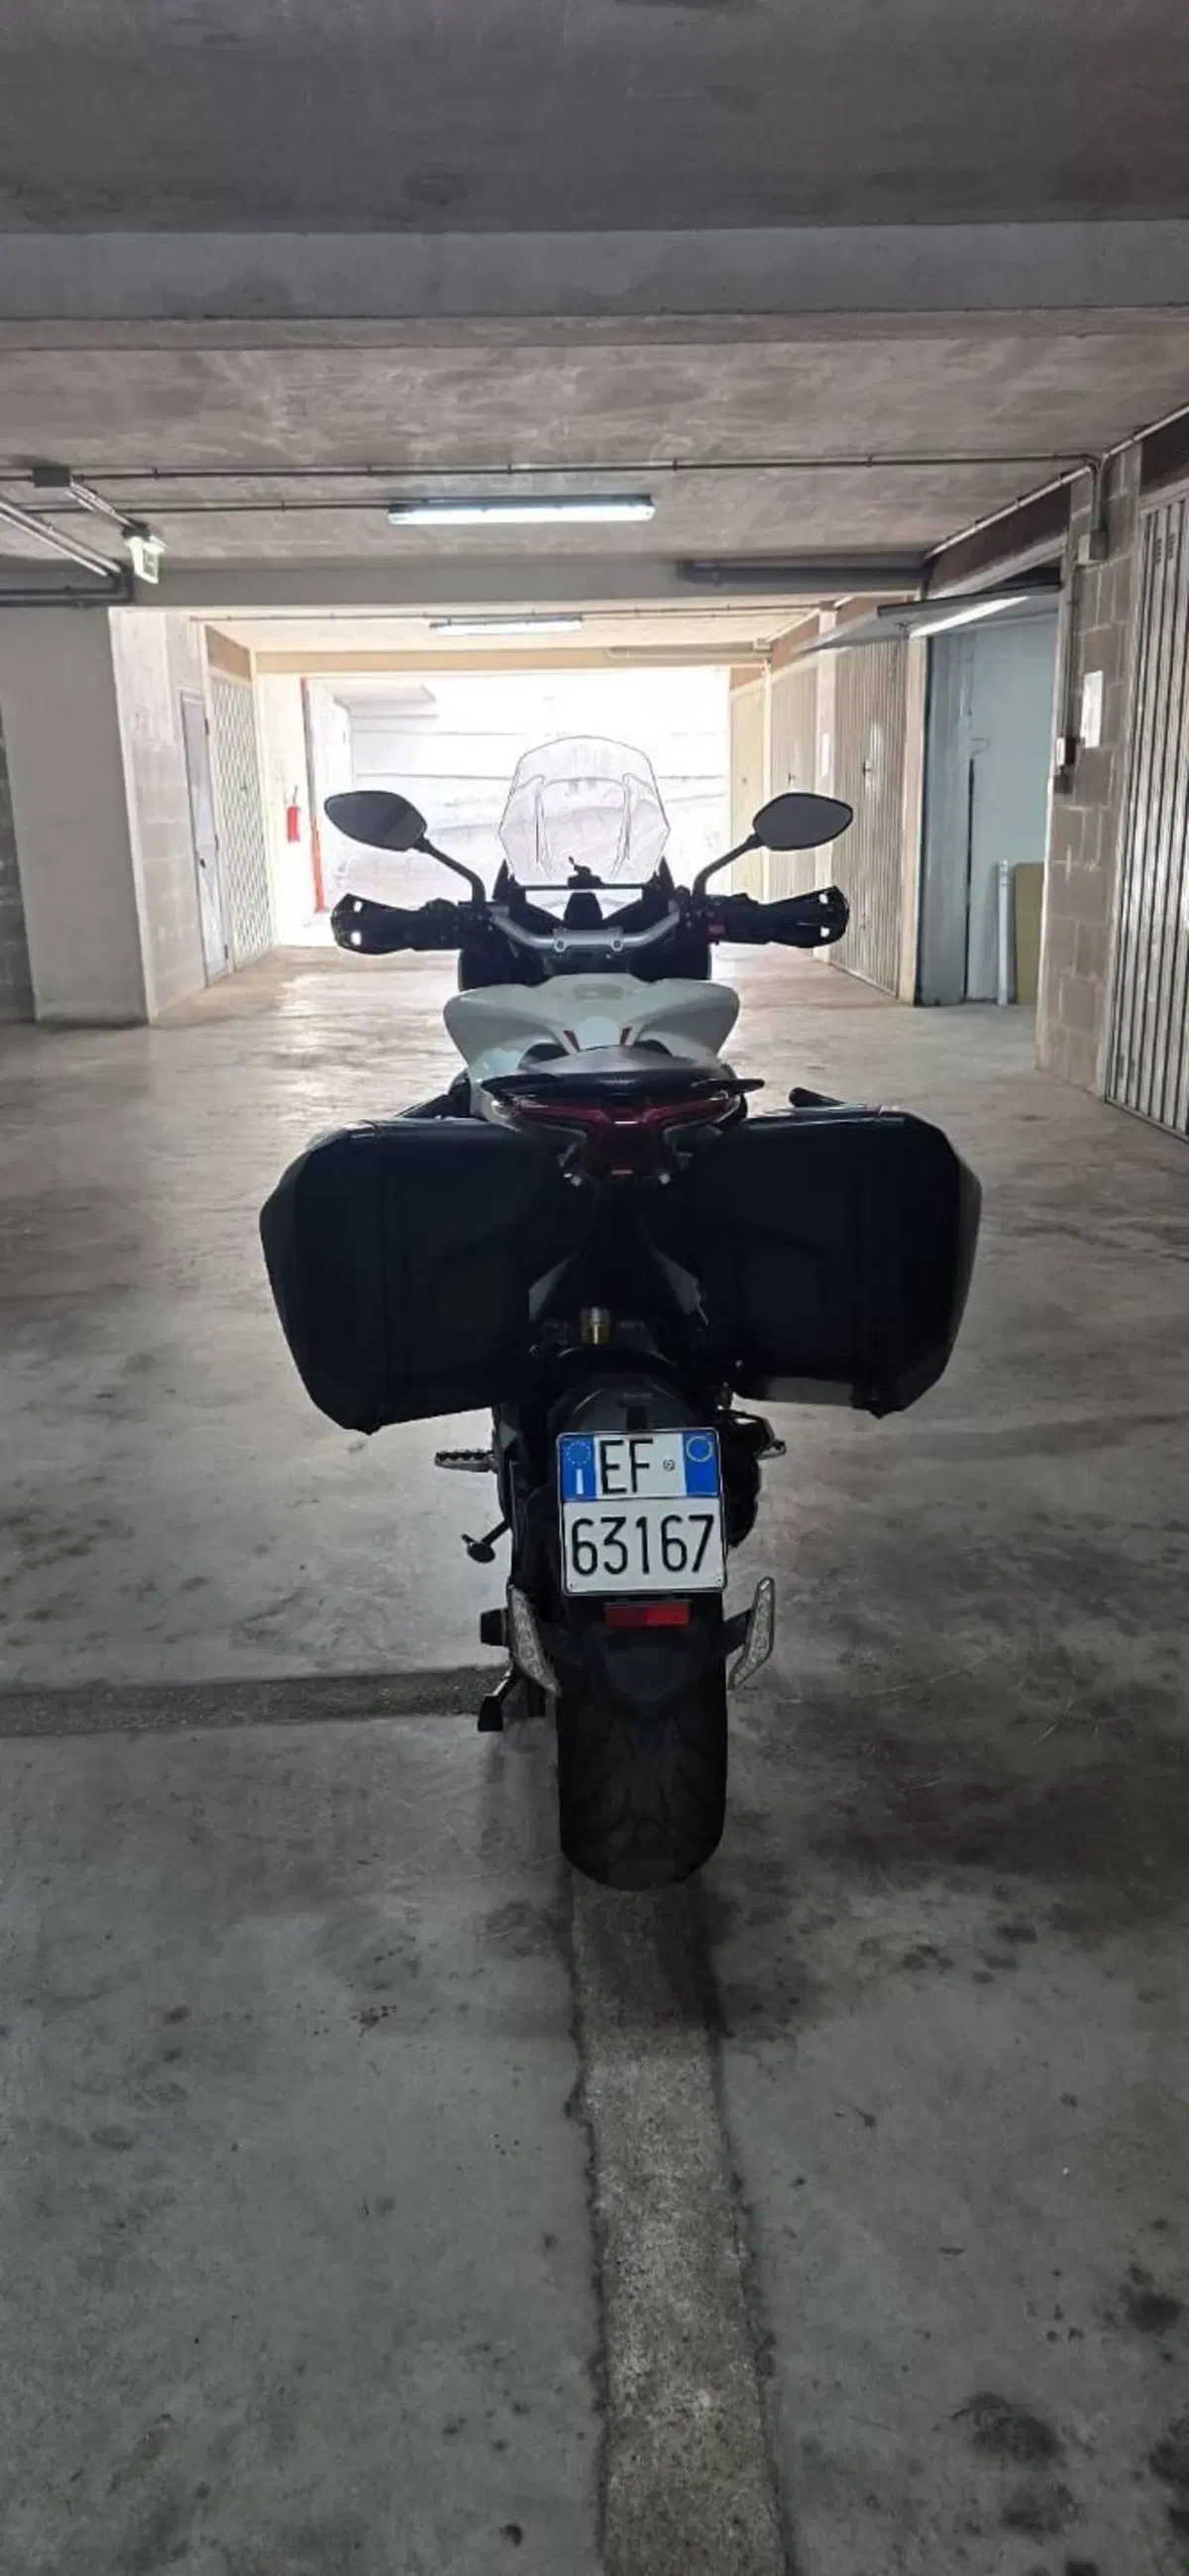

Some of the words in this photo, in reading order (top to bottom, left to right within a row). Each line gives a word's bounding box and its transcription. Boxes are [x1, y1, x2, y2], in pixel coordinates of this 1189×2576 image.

[576, 1468, 584, 1495] I
[598, 1438, 654, 1495] EF
[571, 1513, 714, 1576] 63167
